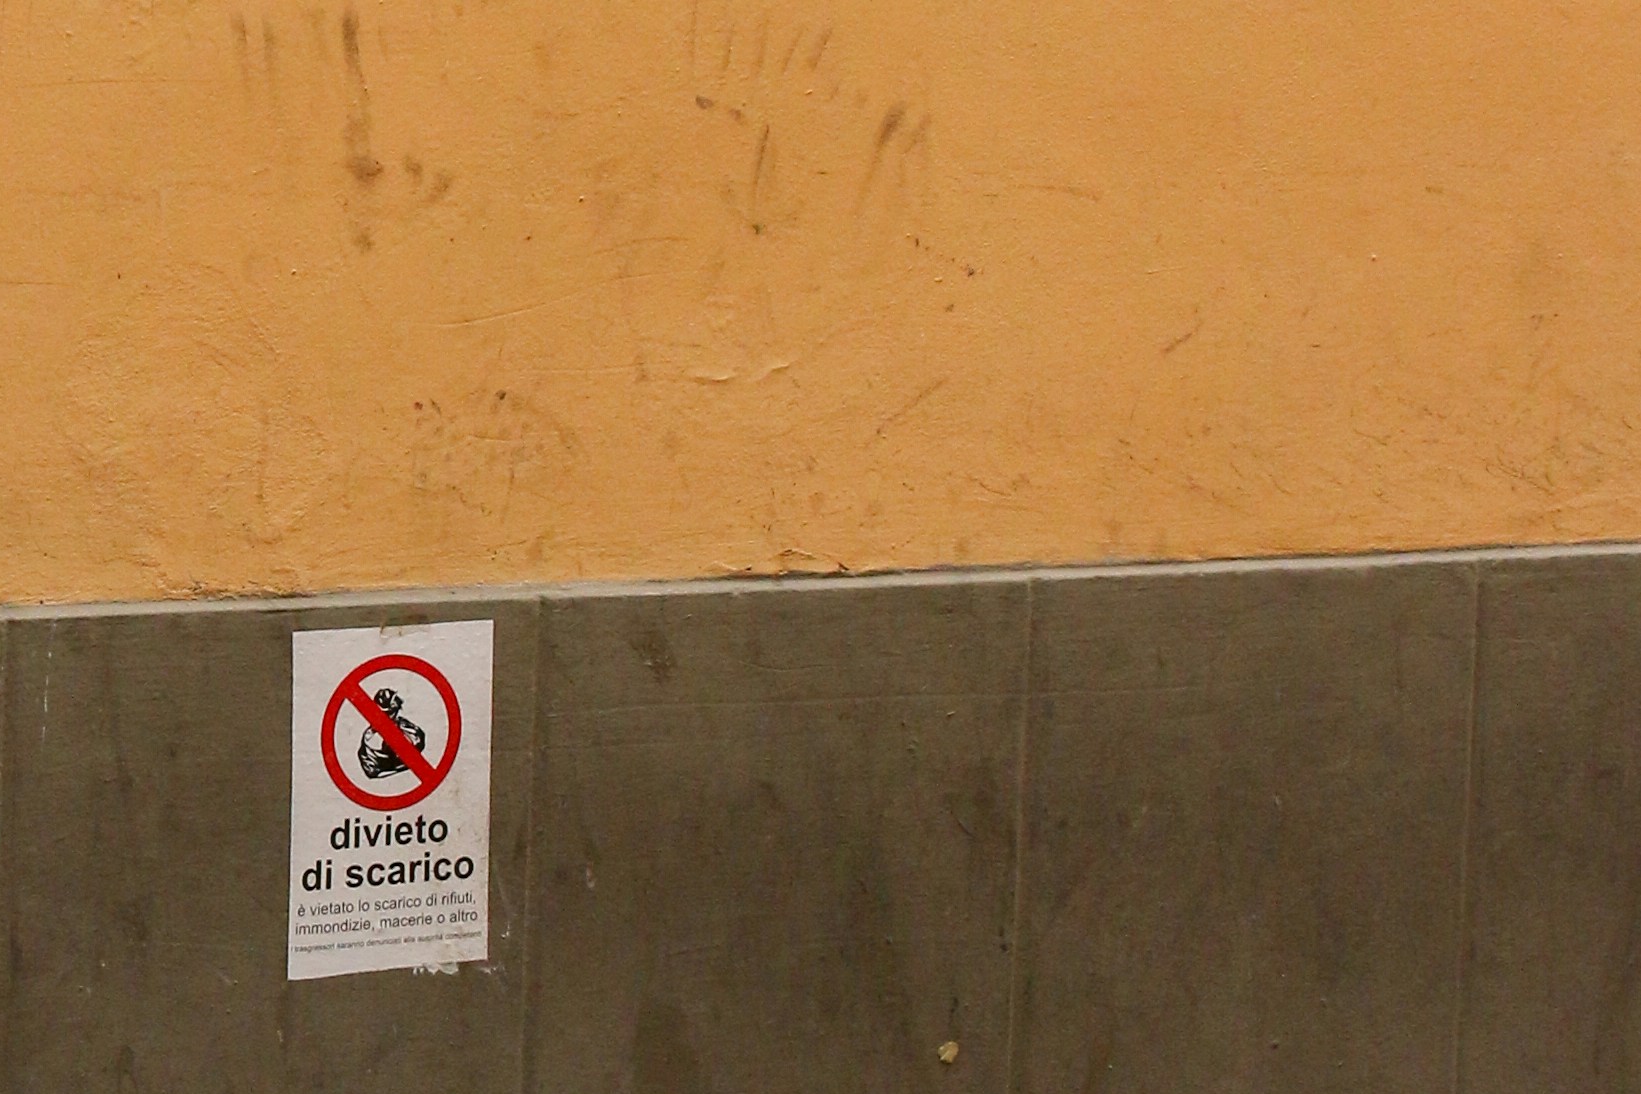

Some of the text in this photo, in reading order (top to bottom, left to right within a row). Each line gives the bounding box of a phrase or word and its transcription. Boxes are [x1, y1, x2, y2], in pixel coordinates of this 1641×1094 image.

[330, 815, 448, 850] divieto
[301, 852, 474, 892] di scarico
[297, 890, 476, 917] è vietato lo scarico di rifiuti,
[295, 909, 478, 935] immondizie, macerie o altro
